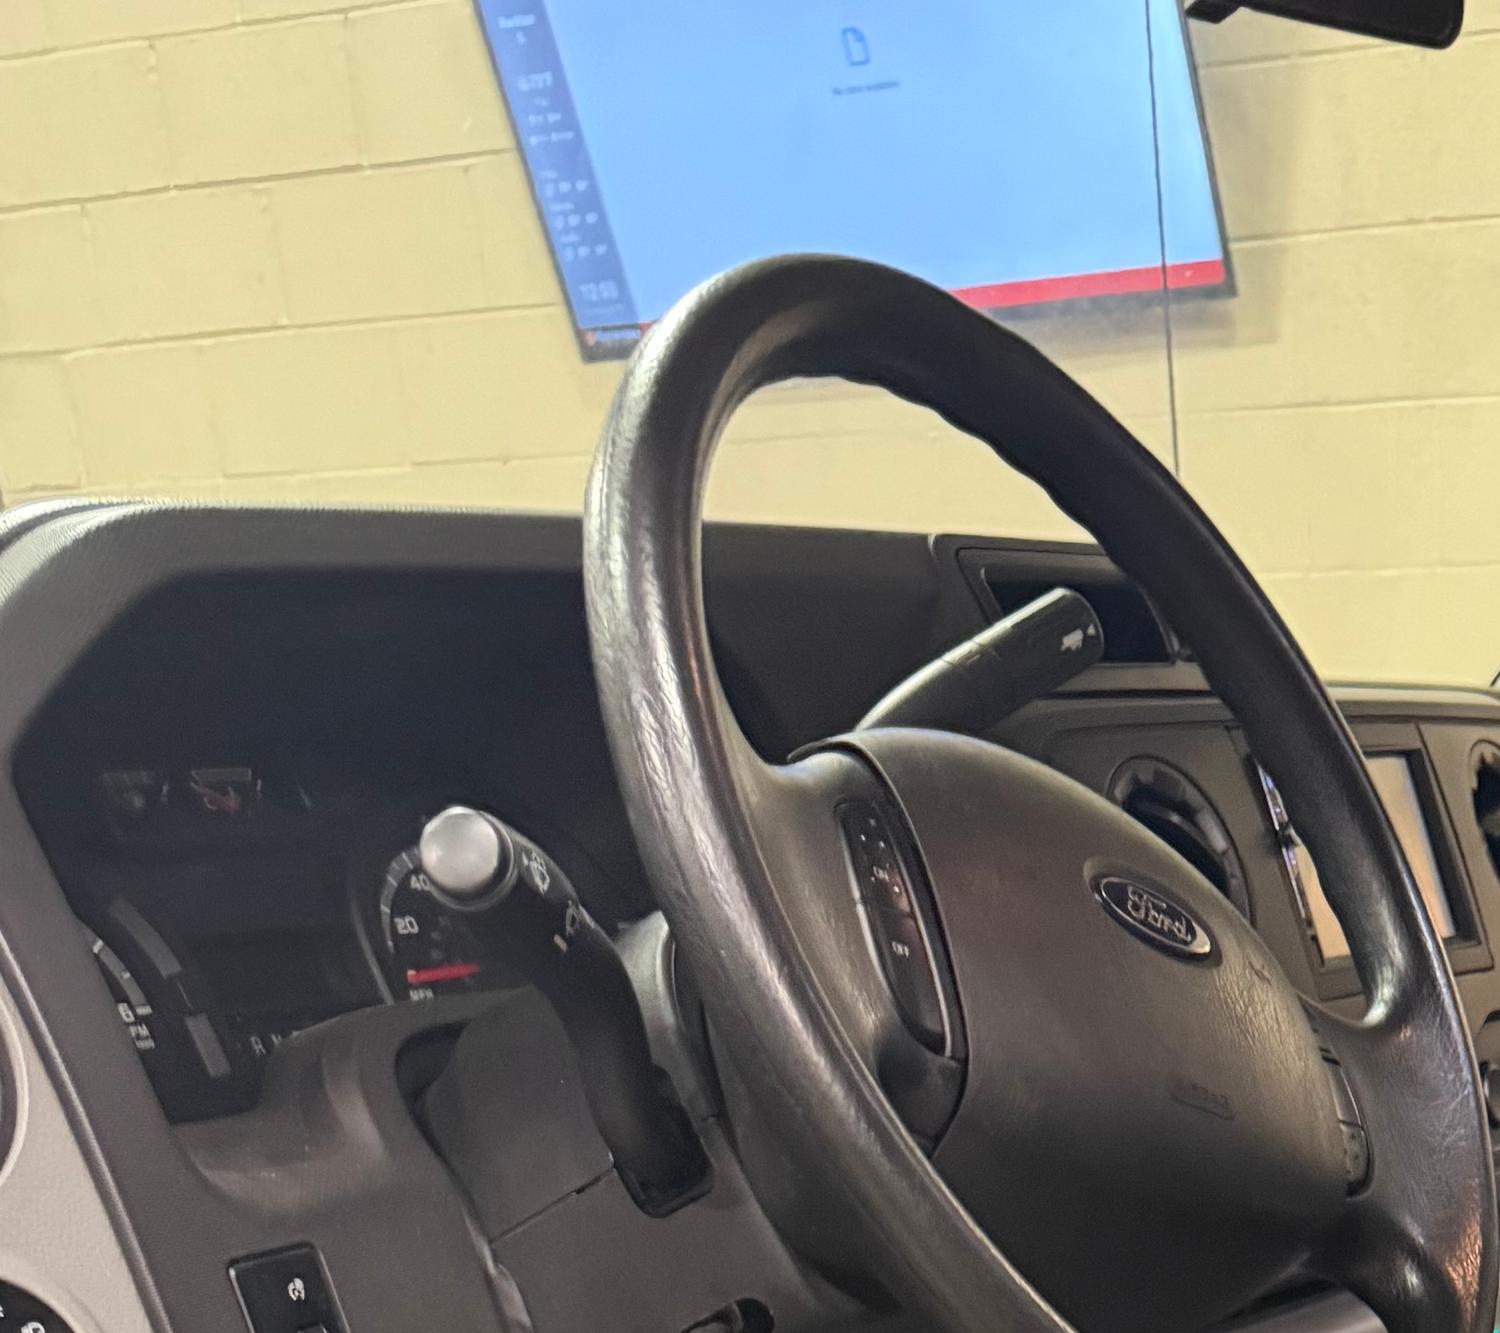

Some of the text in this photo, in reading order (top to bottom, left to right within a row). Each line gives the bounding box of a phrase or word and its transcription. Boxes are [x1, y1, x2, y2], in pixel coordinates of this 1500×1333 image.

[410, 874, 431, 891] 40
[1127, 884, 1192, 942] Ford
[394, 915, 419, 935] 20
